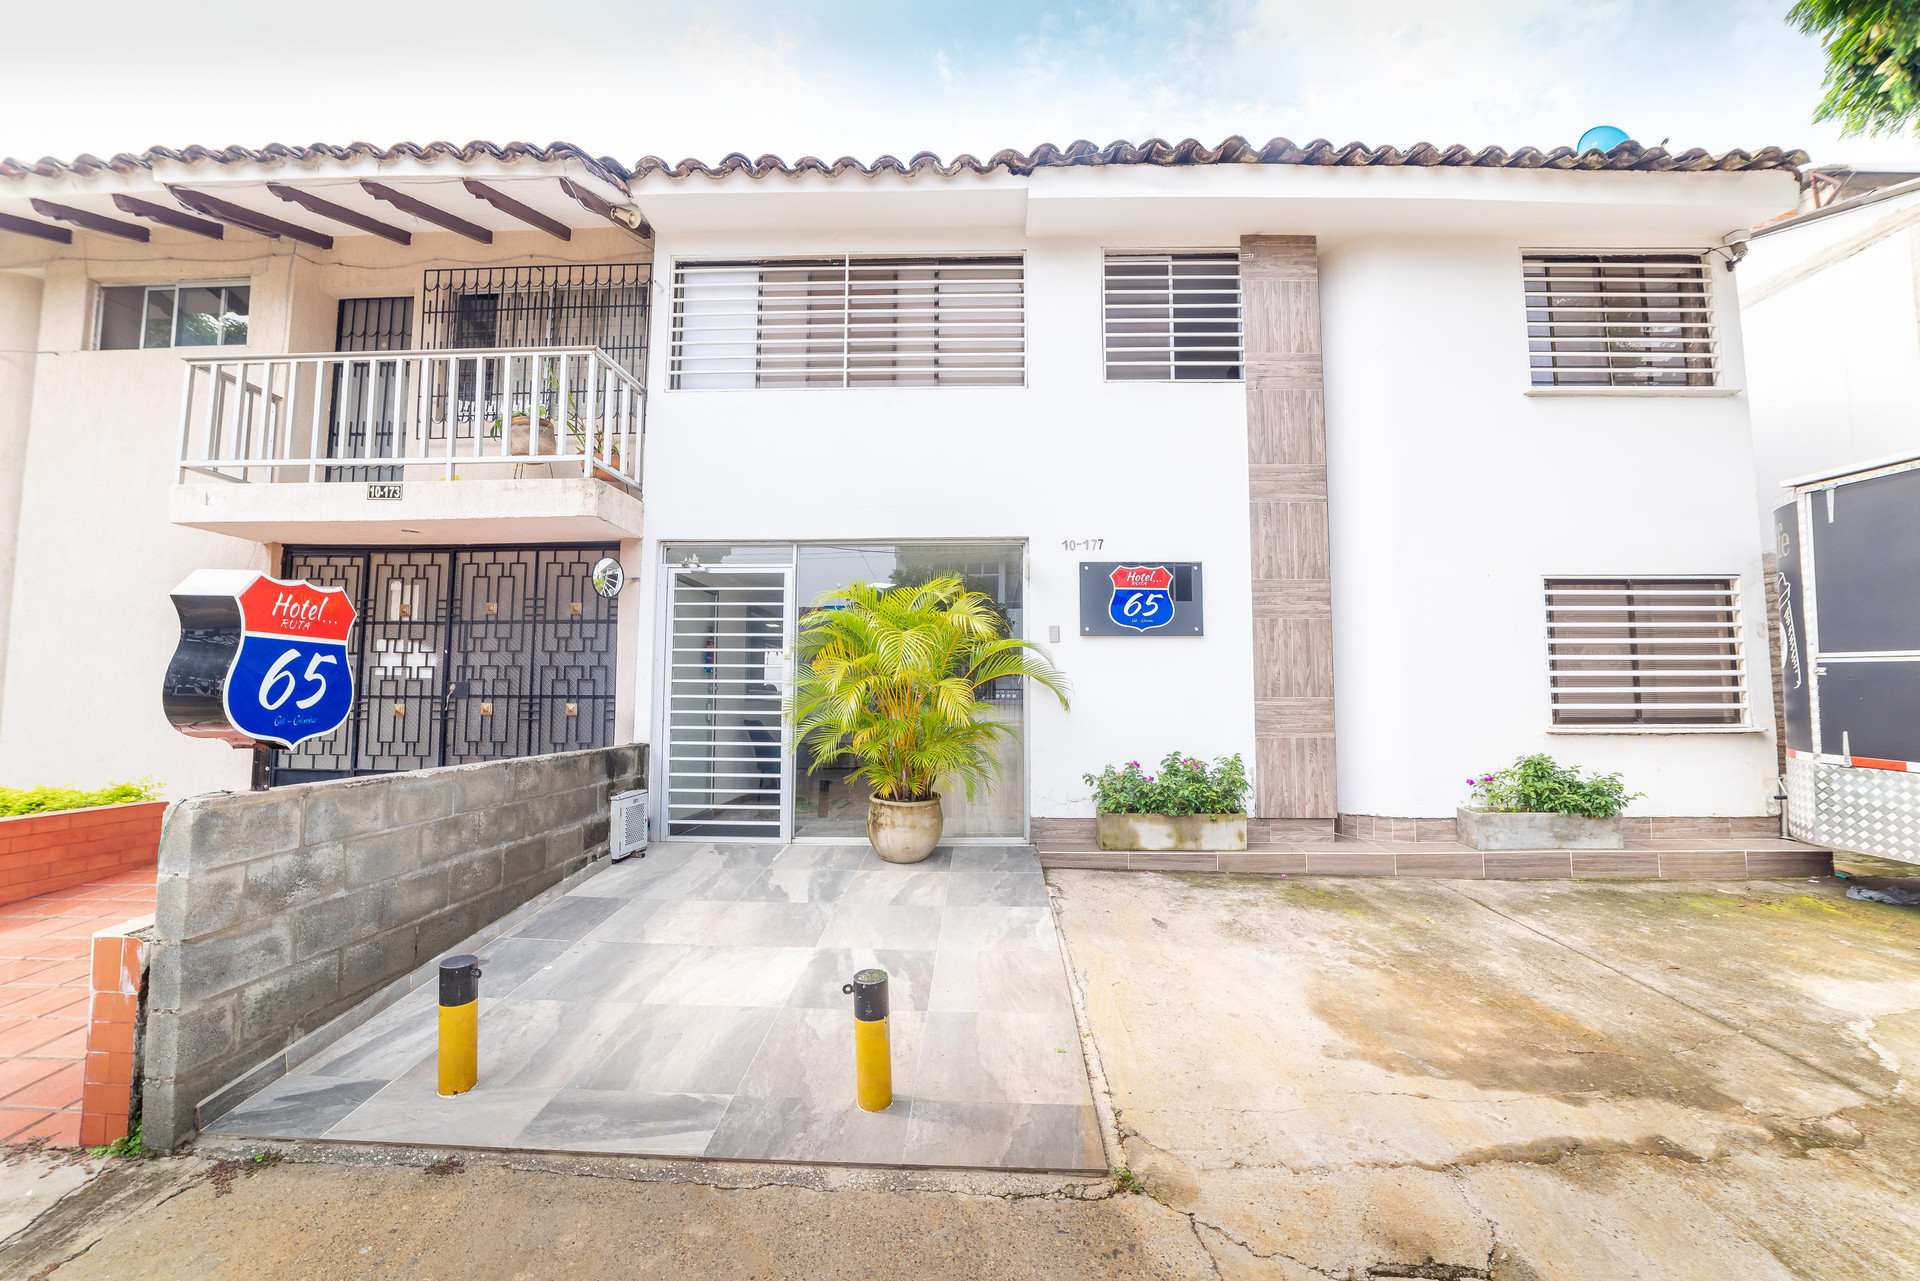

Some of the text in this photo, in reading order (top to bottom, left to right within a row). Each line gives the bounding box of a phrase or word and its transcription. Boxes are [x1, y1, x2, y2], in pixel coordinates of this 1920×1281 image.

[369, 485, 401, 498] 10-173
[1061, 538, 1105, 551] 10-177
[1123, 592, 1164, 617] 65
[280, 618, 311, 631] RUTA
[258, 648, 338, 711] 65
